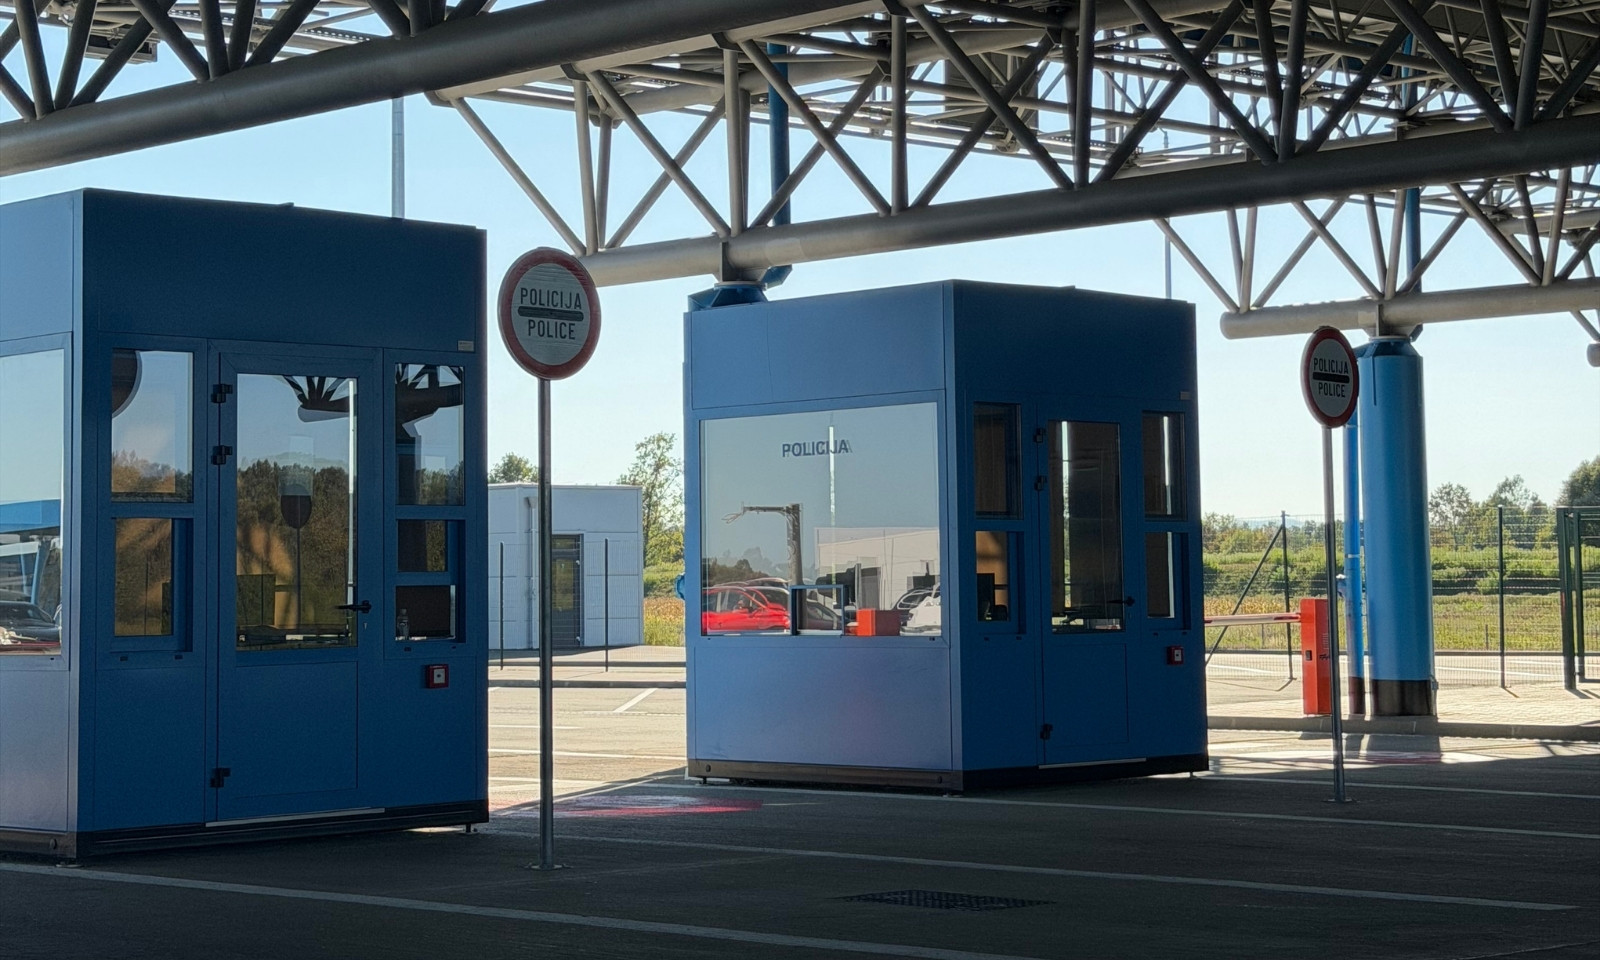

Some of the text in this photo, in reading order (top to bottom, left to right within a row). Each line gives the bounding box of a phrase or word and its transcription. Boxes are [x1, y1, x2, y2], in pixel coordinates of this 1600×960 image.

[520, 287, 582, 310] POLICIJA
[528, 319, 576, 340] POLICE
[1313, 357, 1349, 374] POLICIJA
[1318, 381, 1346, 398] POLICE
[782, 439, 849, 458] POLICIJA
